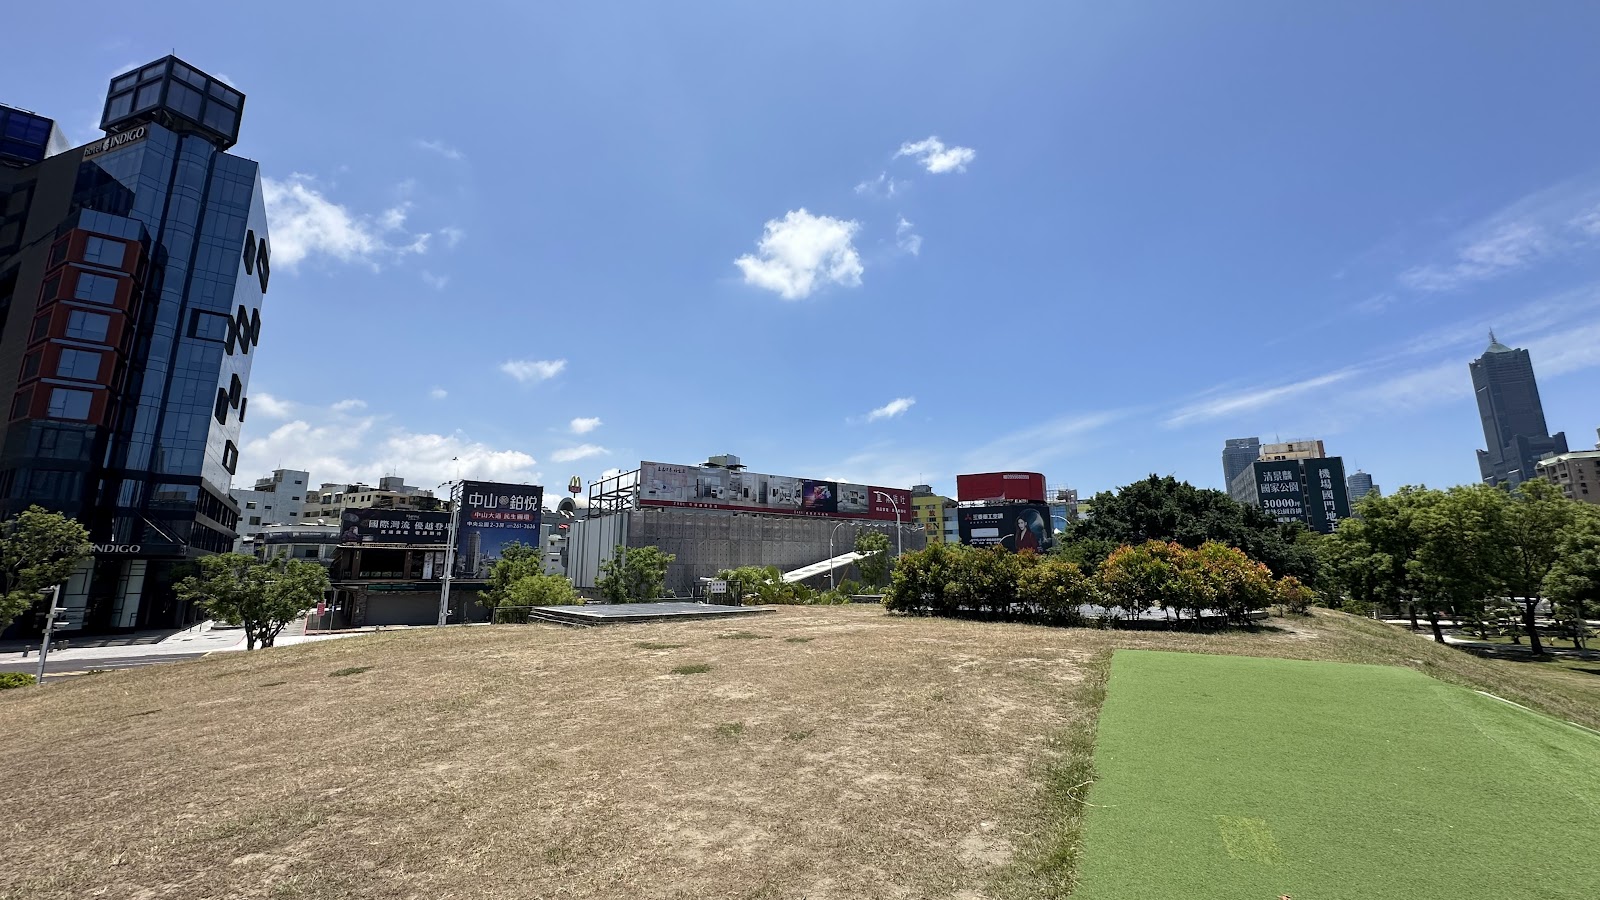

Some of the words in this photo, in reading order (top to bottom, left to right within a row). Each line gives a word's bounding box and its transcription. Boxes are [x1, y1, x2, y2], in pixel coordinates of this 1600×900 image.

[84, 143, 103, 156] hotel
[110, 127, 145, 147] INDIGO
[1261, 482, 1299, 493] 國家公園
[469, 492, 498, 508] 中山
[369, 520, 410, 529] 國際灣流
